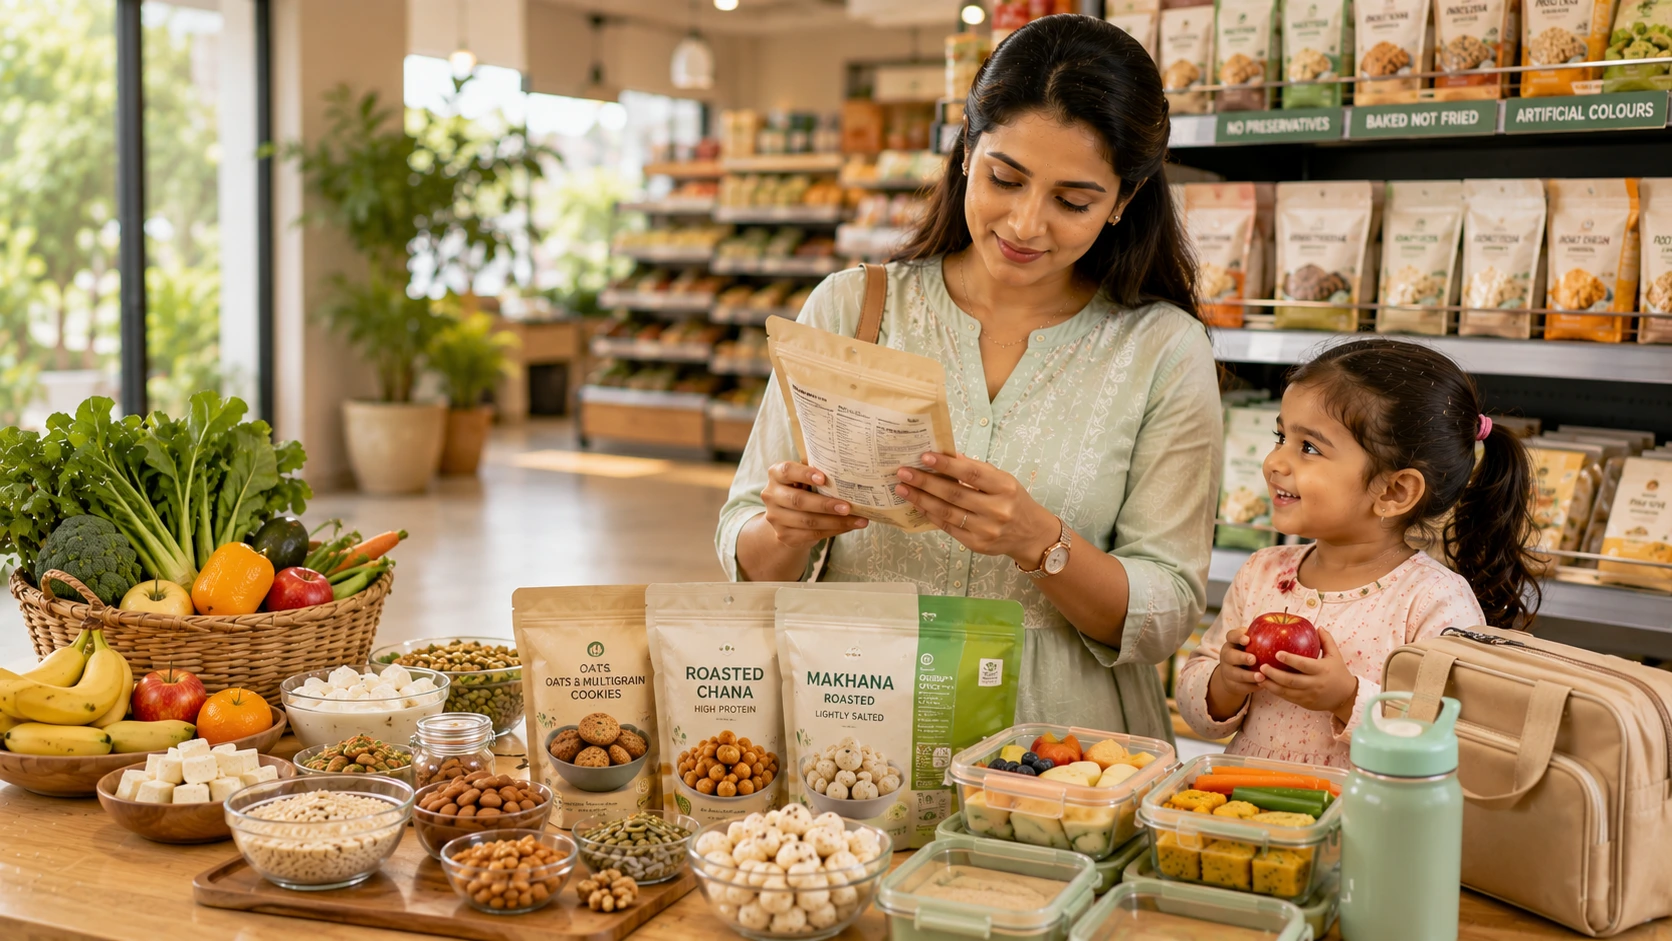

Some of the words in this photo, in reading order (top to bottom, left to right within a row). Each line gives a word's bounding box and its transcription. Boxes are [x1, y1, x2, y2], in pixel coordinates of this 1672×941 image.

[1516, 105, 1585, 123] ARTIFICIAL
[1589, 102, 1654, 120] COLOURS
[1226, 120, 1244, 136] NO
[1246, 116, 1331, 135] PRESERVATIVES
[1366, 113, 1408, 129] BAKED
[1411, 111, 1438, 127] NOT
[1441, 110, 1479, 126] FRIED
[580, 663, 611, 674] OATS
[686, 666, 764, 681] ROASTED
[545, 677, 571, 687] OATS
[583, 676, 645, 687] MULTIGRAIN
[807, 671, 894, 690] MAKHANA
[570, 689, 622, 700] COOKIES
[697, 685, 754, 699] CHANA
[824, 693, 875, 706] ROASTED
[694, 705, 716, 713] HIGH
[718, 705, 756, 713] PROTEIN
[815, 710, 849, 720] LIGHTLY
[852, 712, 884, 722] SALTED
